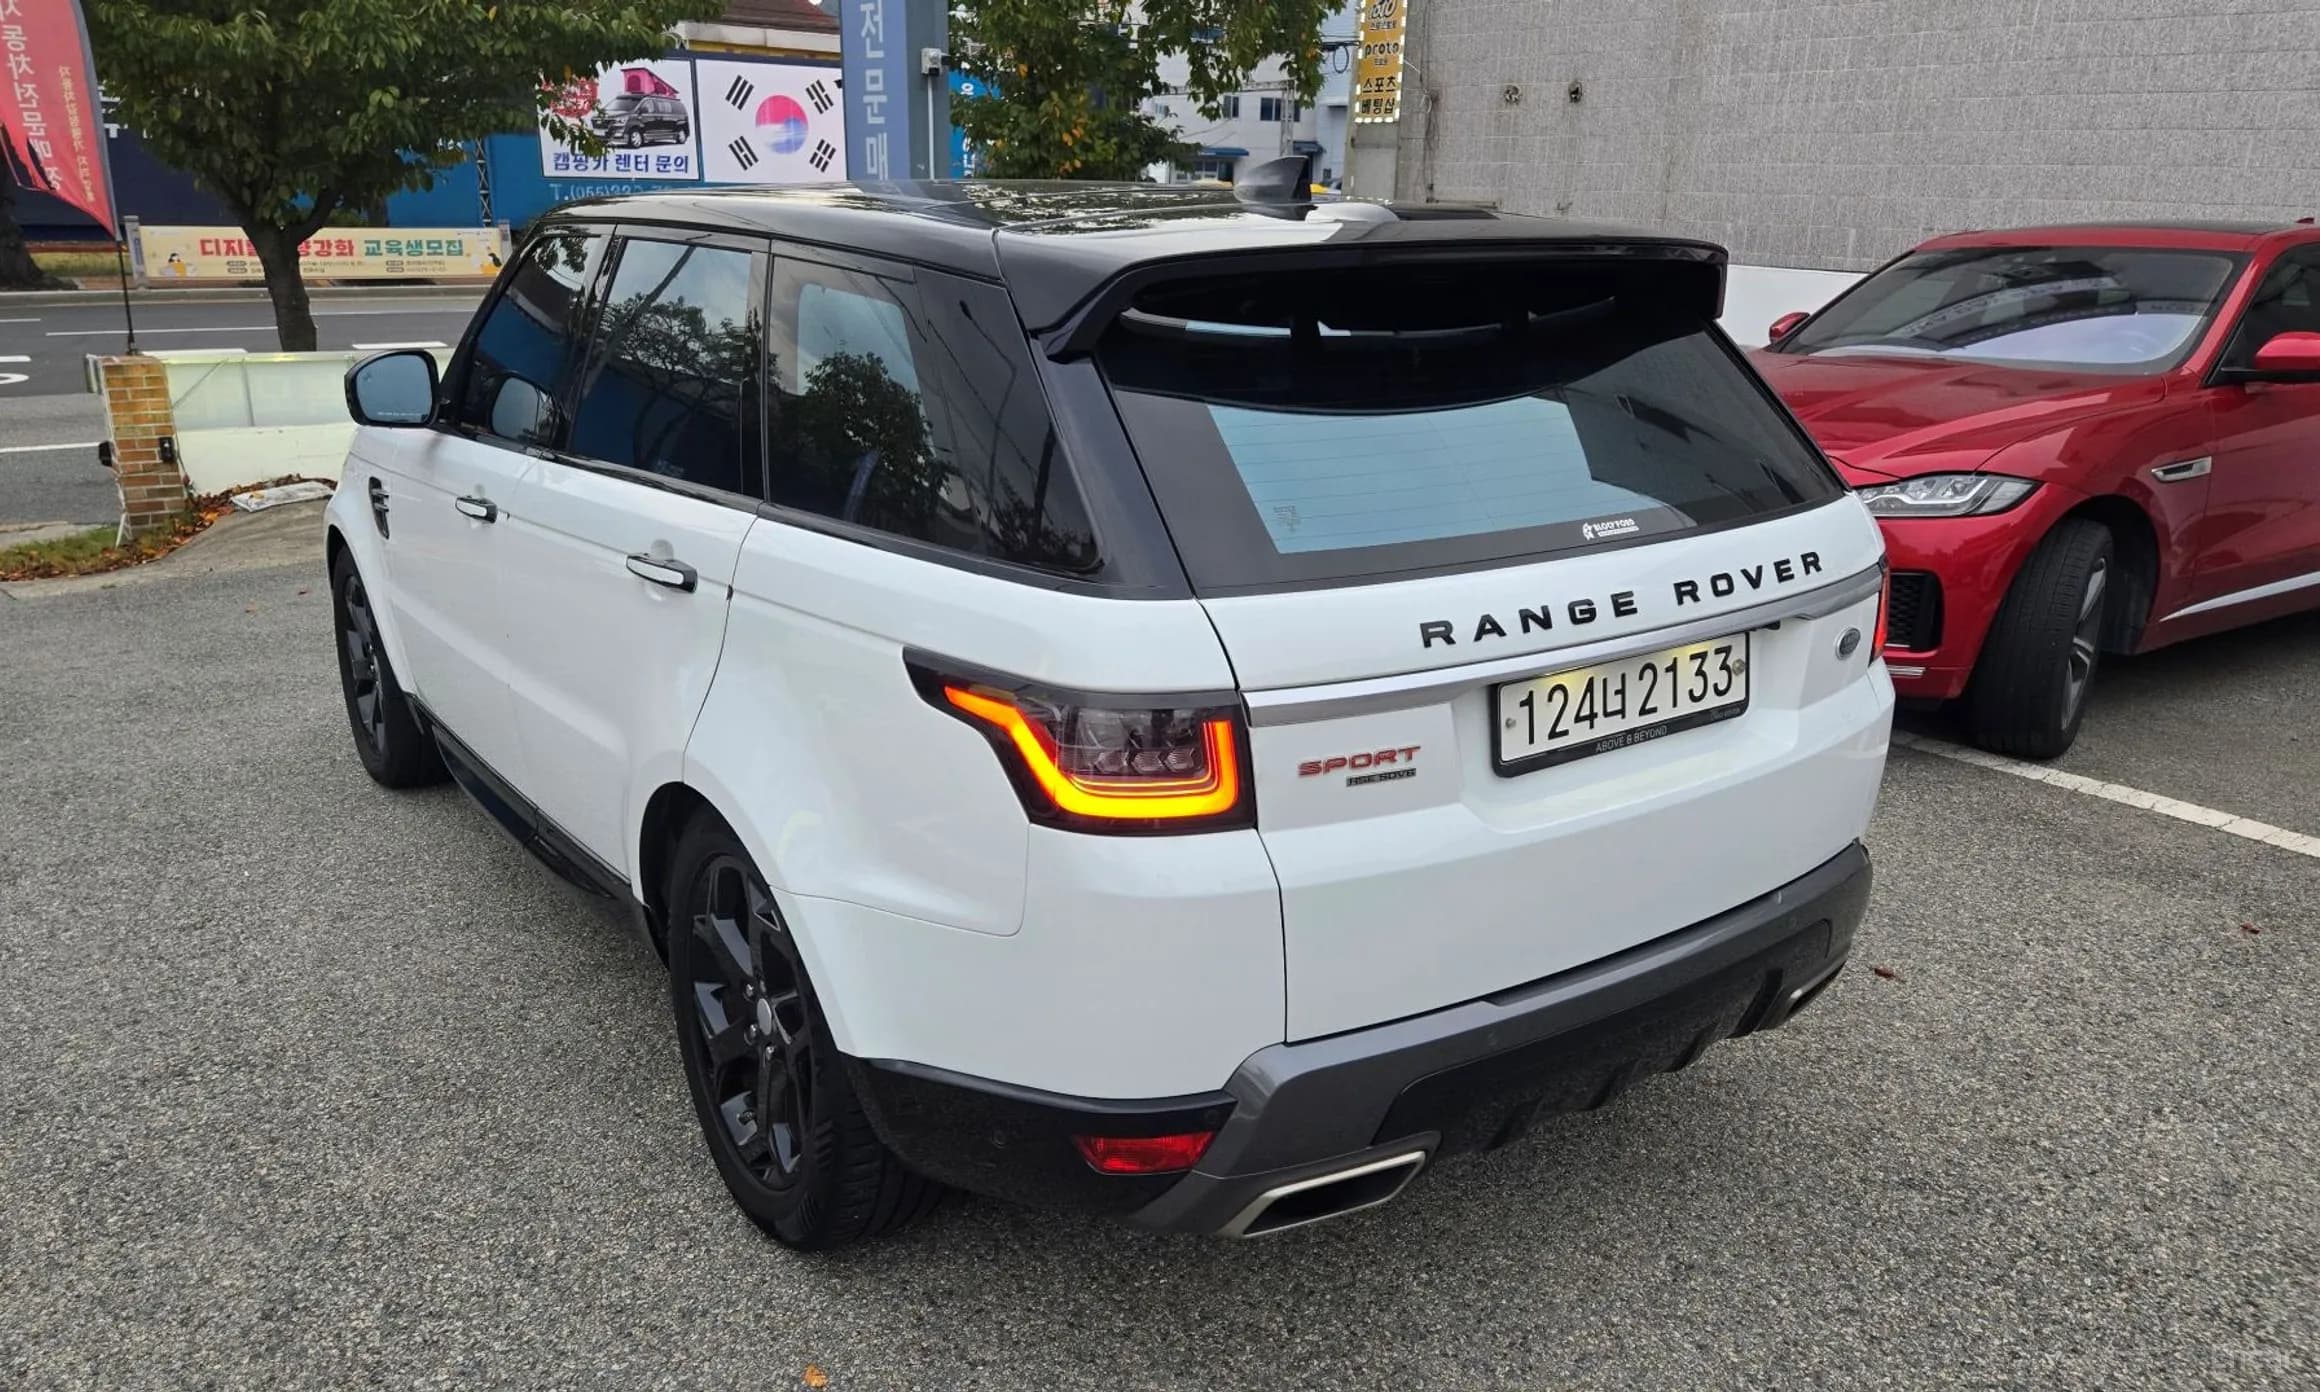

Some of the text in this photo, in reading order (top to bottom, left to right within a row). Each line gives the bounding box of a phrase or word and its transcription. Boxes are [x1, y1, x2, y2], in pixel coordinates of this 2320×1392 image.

[1364, 42, 1400, 58] proto
[1362, 76, 1397, 94] 스포츠
[614, 154, 650, 173] 렌터
[654, 155, 690, 174] 문의
[363, 239, 465, 257] 교육생모집
[1420, 551, 1823, 648] RANGE ROVER
[1638, 644, 1734, 717] 2133
[1595, 735, 1626, 753] ABOVE
[1633, 724, 1668, 743] BEYOND
[1298, 745, 1422, 777] SPORT
